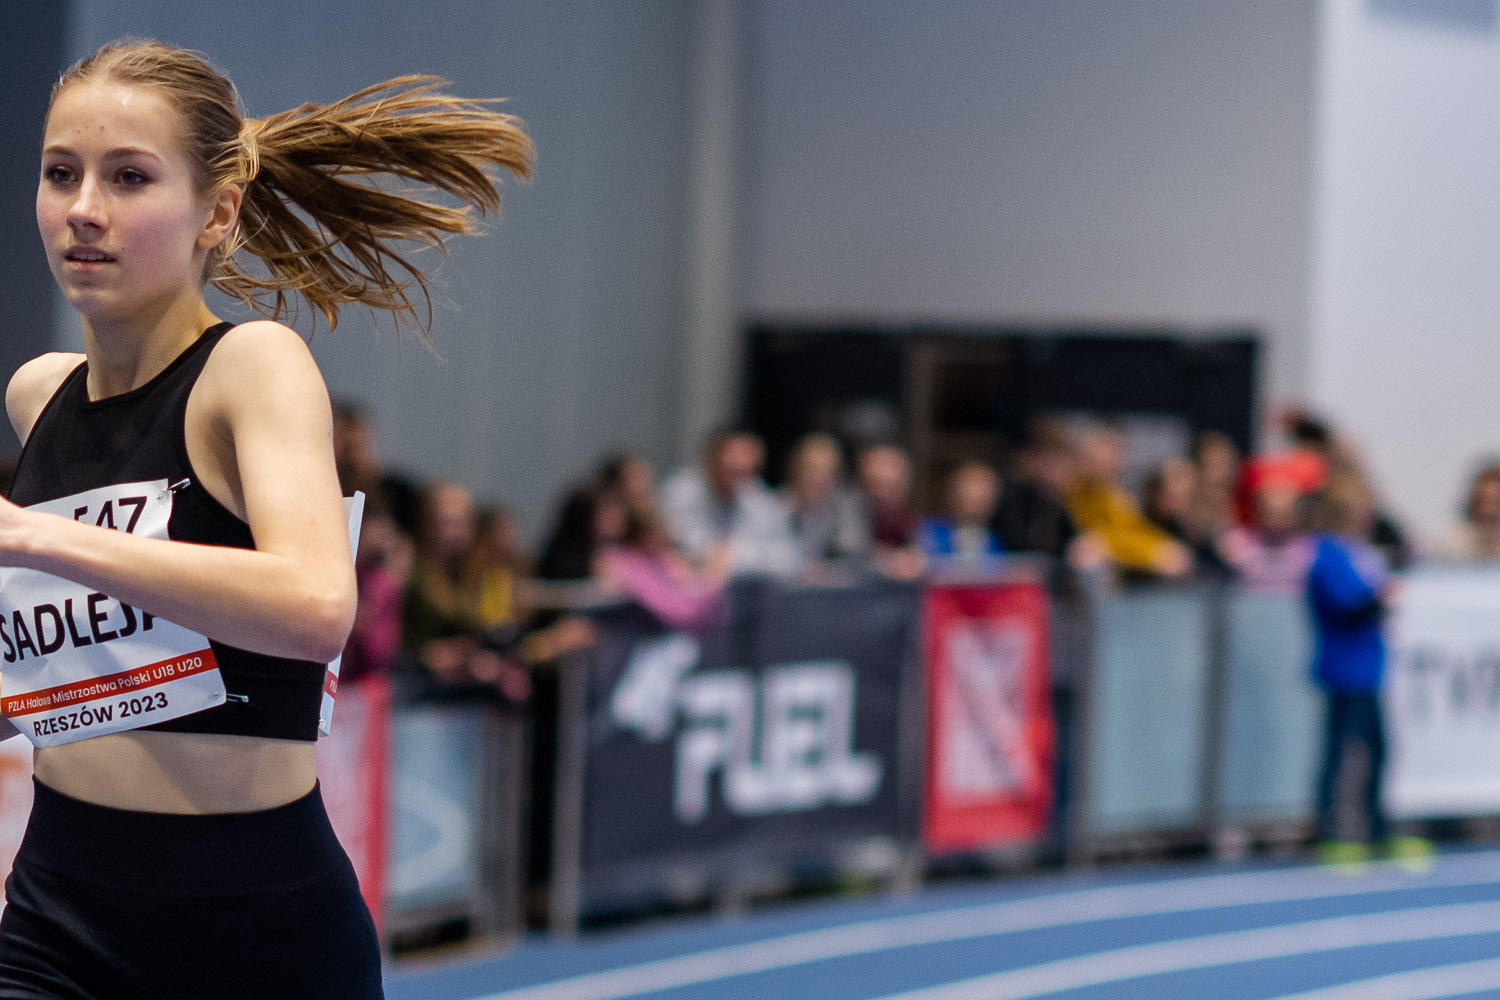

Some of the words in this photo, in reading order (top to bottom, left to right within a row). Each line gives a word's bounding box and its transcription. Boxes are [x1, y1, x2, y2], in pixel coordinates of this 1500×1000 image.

[8, 699, 26, 713] PZLA
[52, 680, 117, 704] Mistrzostwa
[117, 670, 151, 689] Polski
[152, 663, 175, 680] U18
[177, 656, 202, 673] U20
[33, 704, 114, 738] RZESZÓW
[118, 691, 169, 719] 2023
